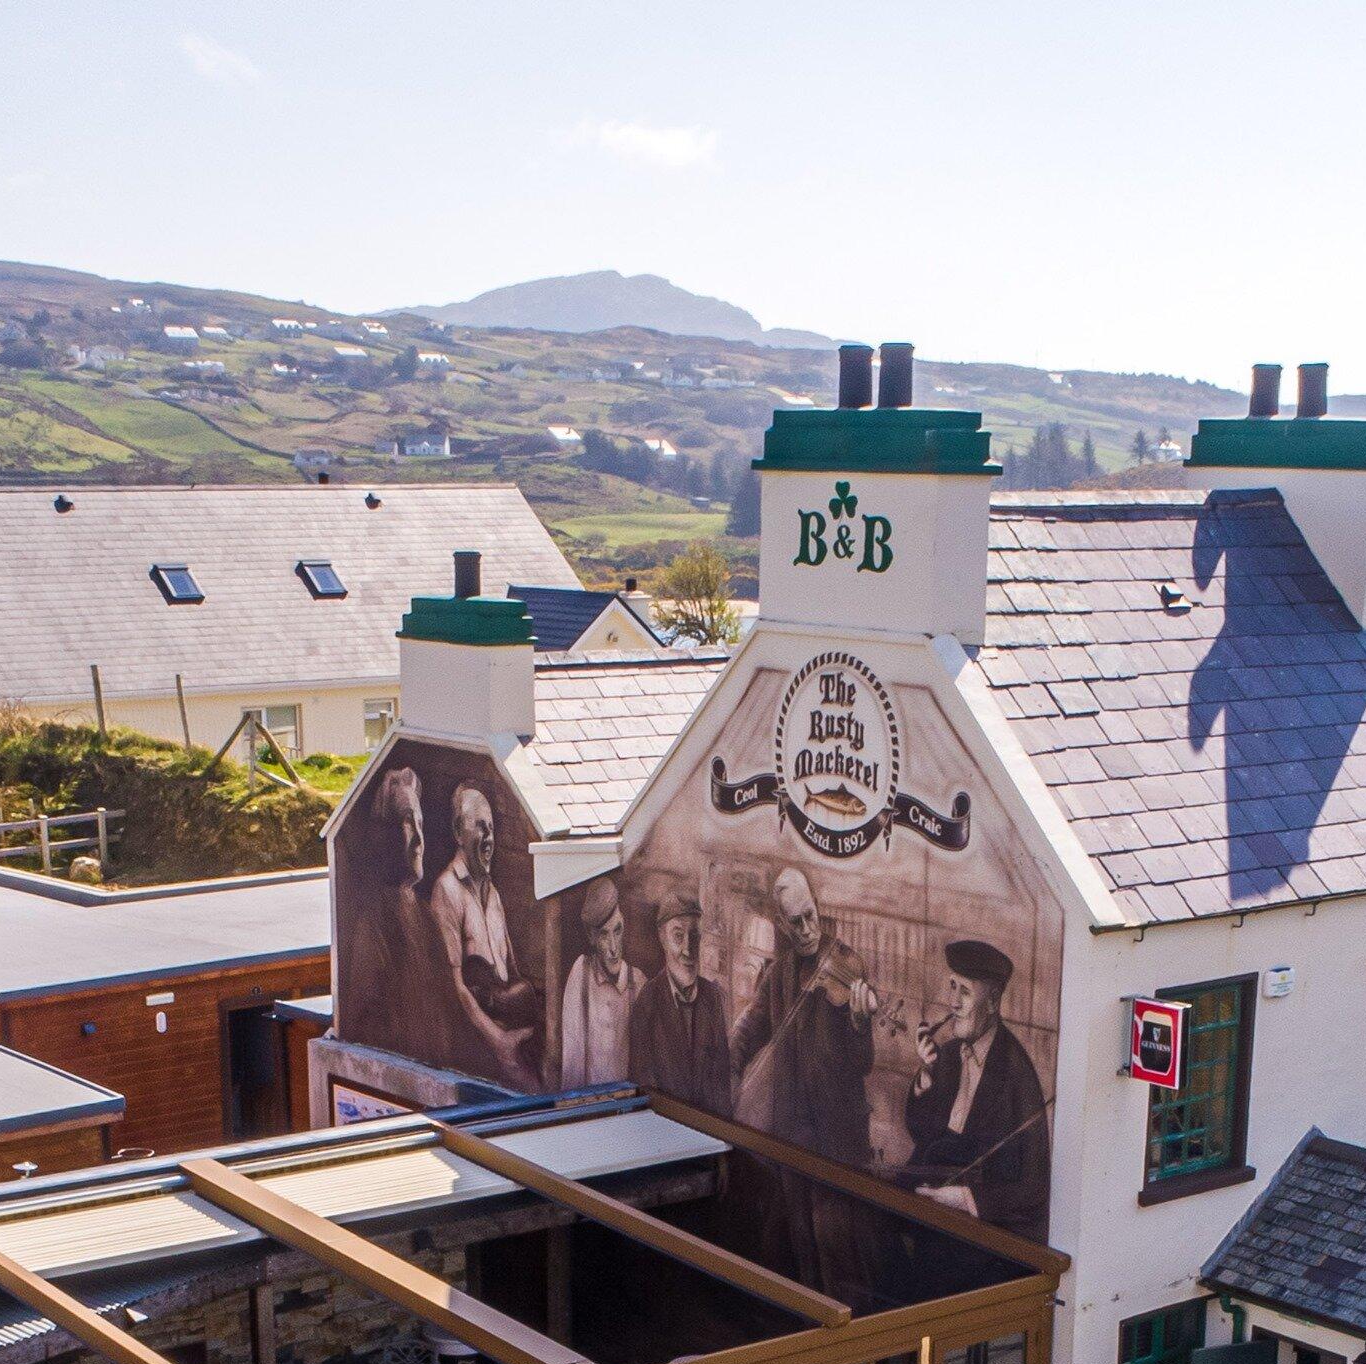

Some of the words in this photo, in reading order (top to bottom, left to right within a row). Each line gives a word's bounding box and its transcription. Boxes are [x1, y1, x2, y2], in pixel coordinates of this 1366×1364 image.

[792, 508, 894, 574] B&B
[819, 671, 856, 707] The
[808, 709, 864, 751] Rusty
[793, 744, 879, 793] Mackerel
[734, 783, 758, 805] Ceol
[803, 820, 833, 853] Estd.
[837, 830, 867, 853] 1892
[909, 805, 942, 836] Craic
